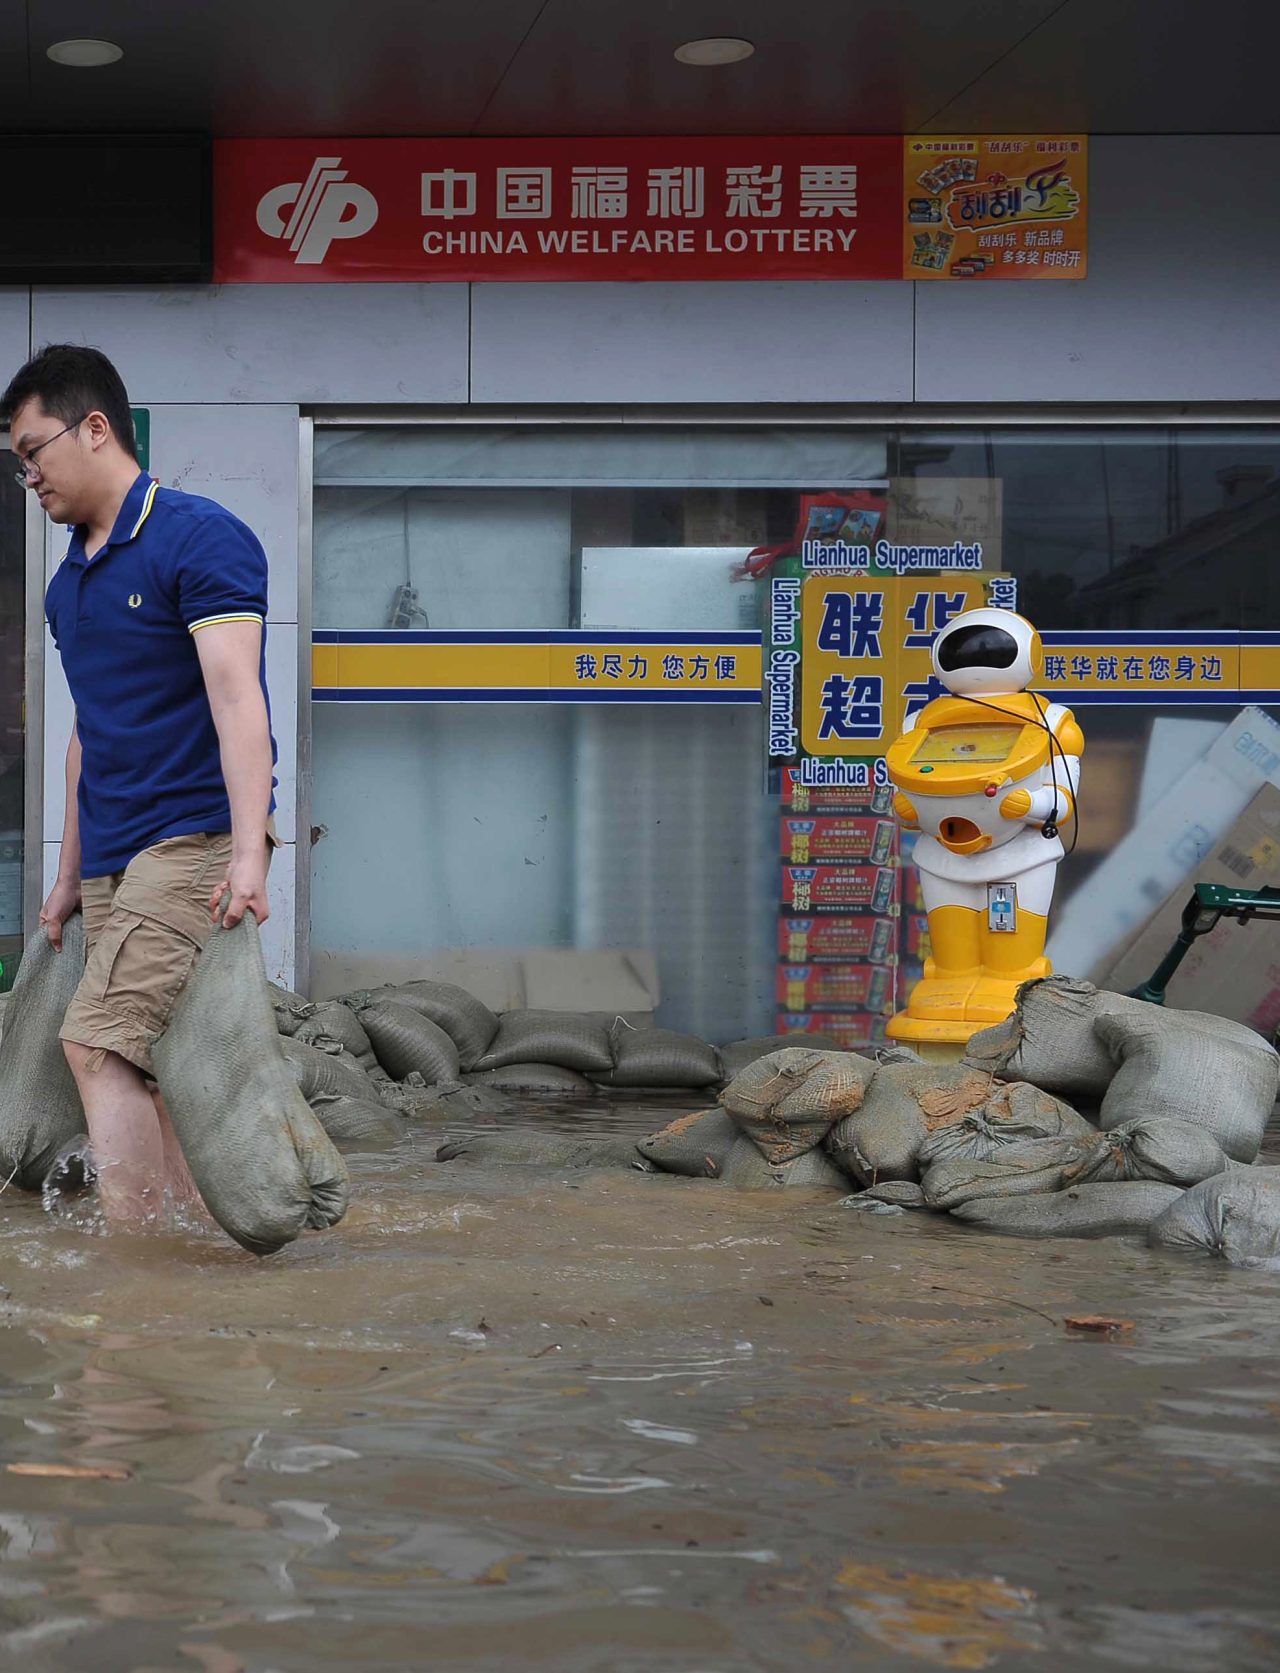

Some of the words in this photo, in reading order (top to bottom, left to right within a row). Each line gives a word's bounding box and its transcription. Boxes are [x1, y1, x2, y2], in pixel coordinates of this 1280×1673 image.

[420, 165, 858, 220] 中国福利彩票
[422, 229, 527, 255] CHINA
[537, 229, 697, 255] WELFARE
[705, 228, 857, 254] LOTTERY
[978, 232, 1017, 248] 刮刮乐
[1023, 229, 1064, 247] 新品牌
[1003, 250, 1040, 264] 多多奖
[1043, 250, 1081, 267] 时时开
[802, 540, 870, 569] Lianhua
[875, 539, 982, 574] Supermarket
[772, 578, 801, 645] Lianhua
[817, 591, 968, 658] 联华
[574, 653, 648, 680] 我尽力
[661, 653, 738, 680] 您方便
[1043, 653, 1224, 681] 联华就在您身边
[764, 649, 801, 756] Supermarket
[801, 757, 870, 787] Lianhua
